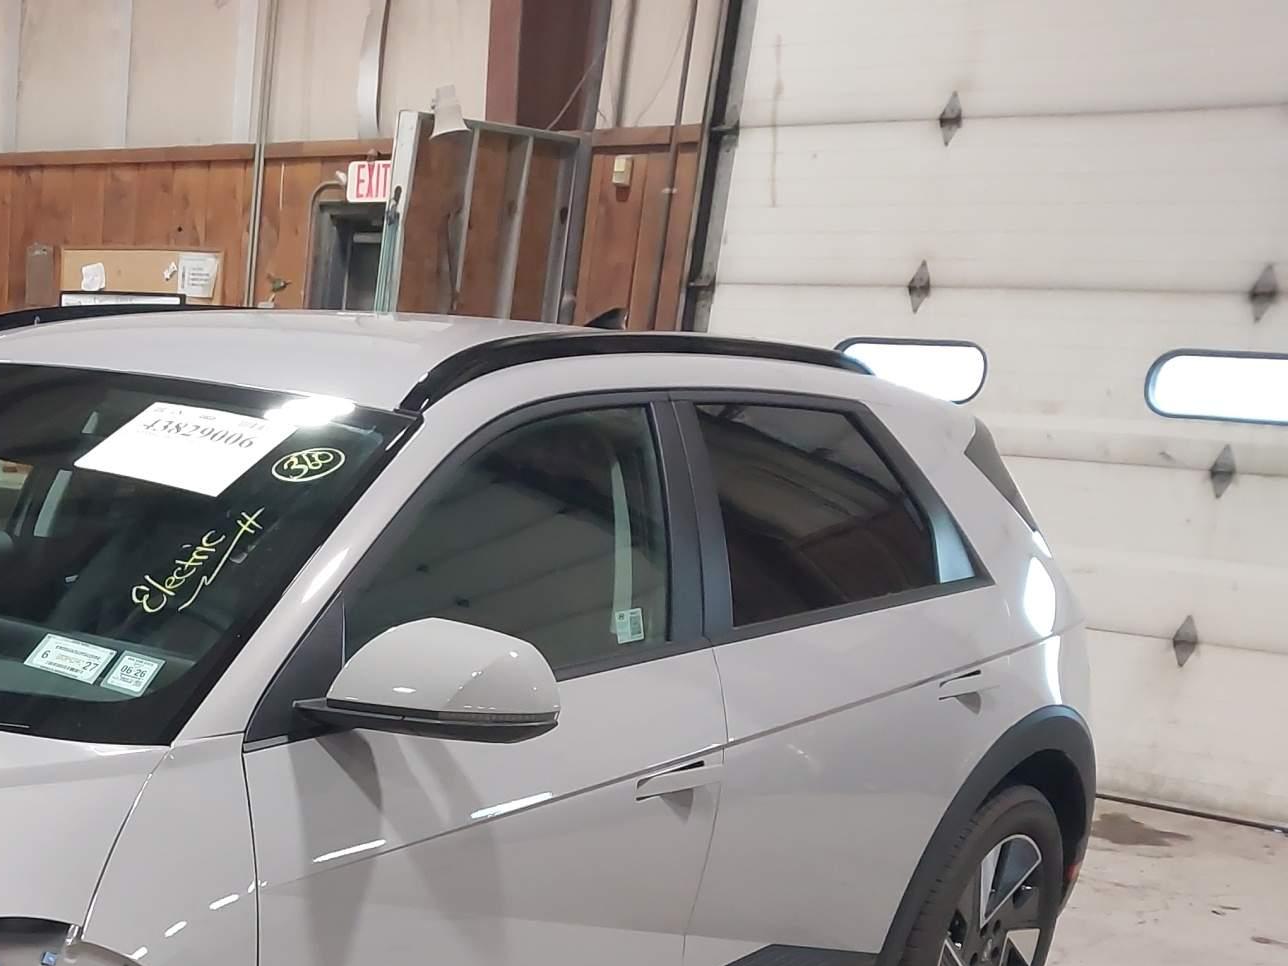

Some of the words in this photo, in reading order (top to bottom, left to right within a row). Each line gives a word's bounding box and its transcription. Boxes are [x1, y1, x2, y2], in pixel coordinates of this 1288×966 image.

[355, 163, 391, 199] EXIT
[143, 418, 257, 449] 43829006
[131, 529, 227, 613] Electric
[82, 661, 100, 672] 27
